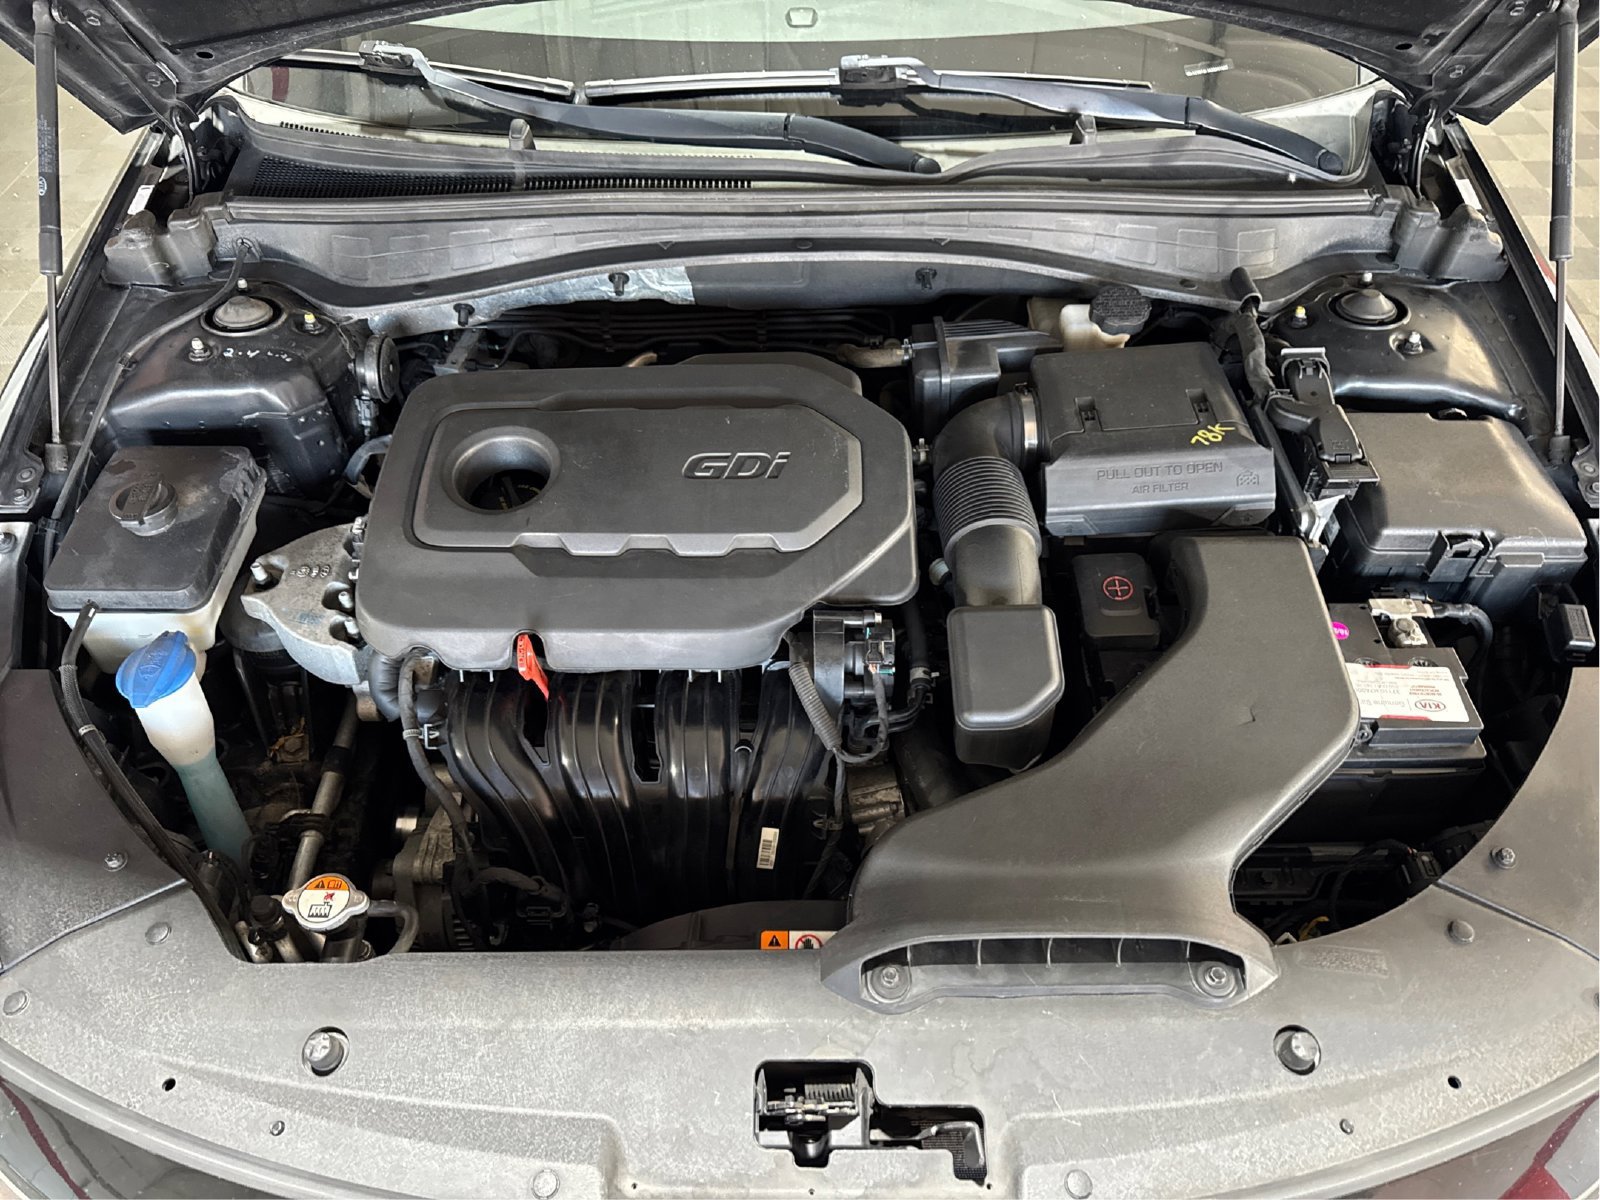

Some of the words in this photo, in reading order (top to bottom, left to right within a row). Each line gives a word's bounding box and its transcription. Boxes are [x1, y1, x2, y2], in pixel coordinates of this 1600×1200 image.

[1190, 423, 1235, 446] 78K
[681, 451, 791, 479] GDi
[1096, 468, 1131, 480] PULL
[1134, 466, 1161, 478] OUT
[1166, 464, 1183, 476] TO
[1186, 461, 1223, 474] OPEN
[1131, 484, 1150, 494] AIR
[1152, 481, 1189, 493] FILTER
[1417, 700, 1443, 711] KIA
